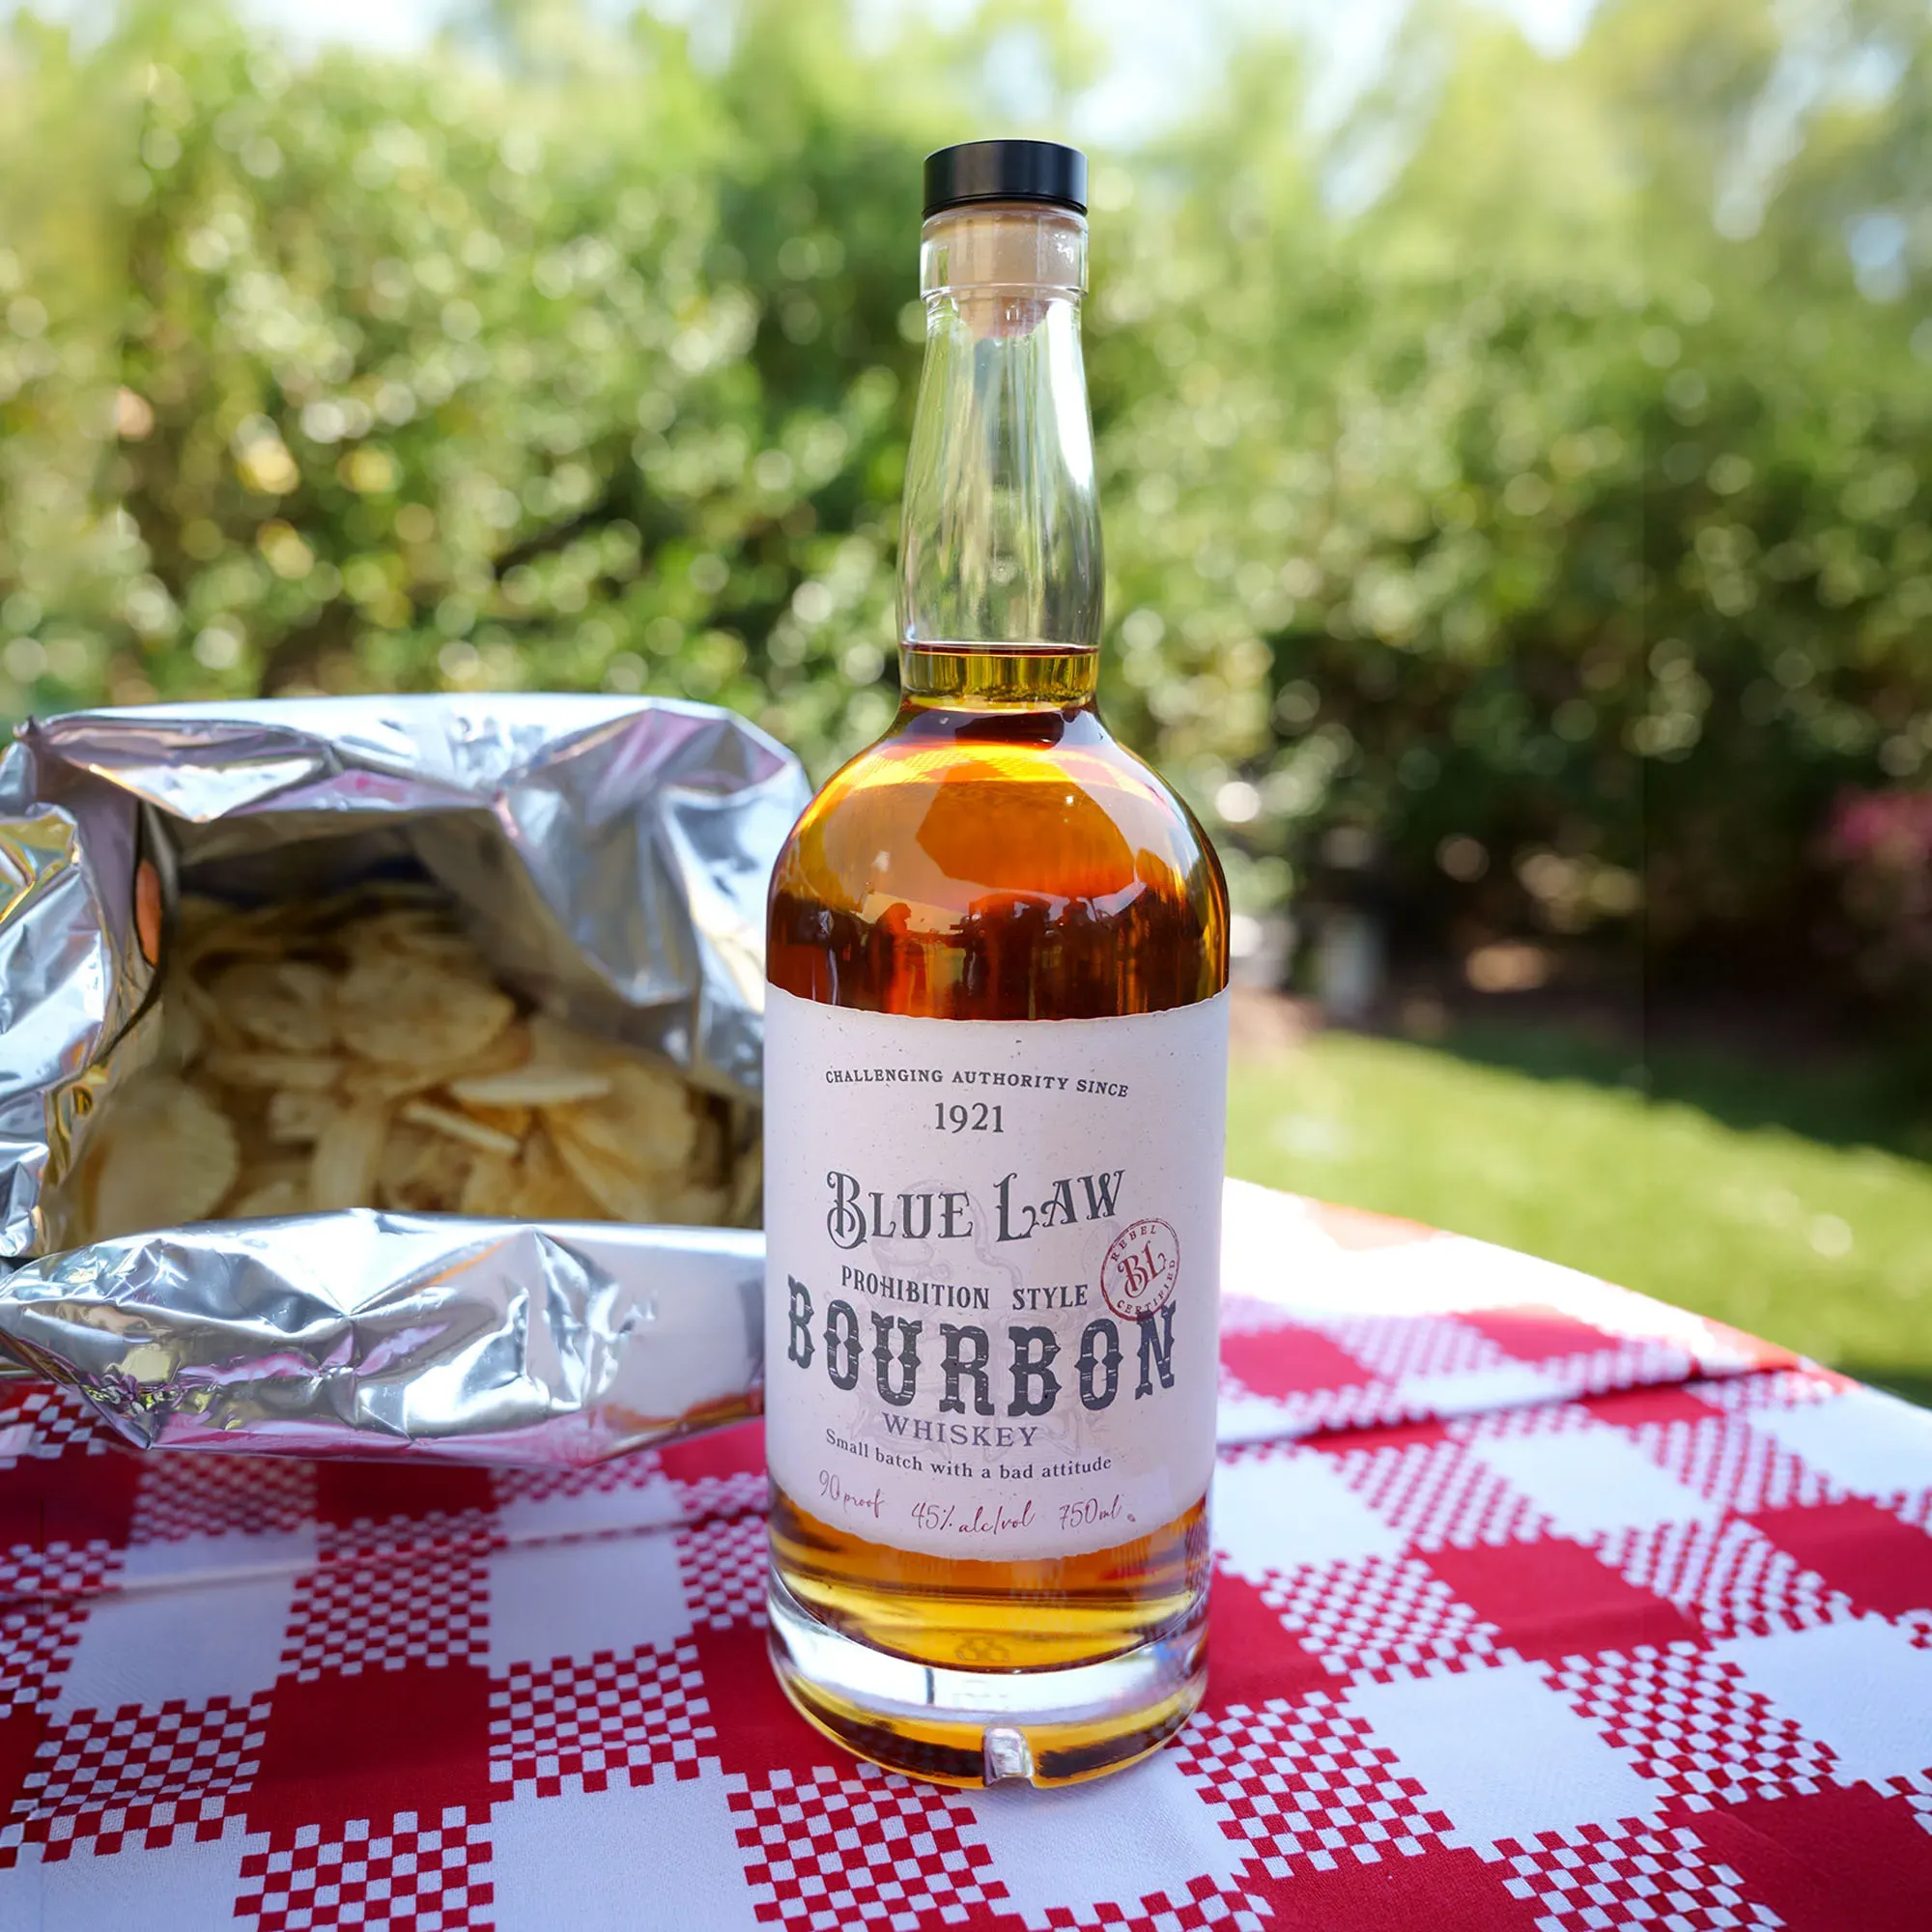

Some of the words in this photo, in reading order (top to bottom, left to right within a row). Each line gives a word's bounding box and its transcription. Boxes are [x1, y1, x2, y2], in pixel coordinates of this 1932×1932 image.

[826, 1068, 944, 1084] CHALLENGING
[952, 1070, 1069, 1091] AUTHORITY
[1076, 1078, 1129, 1097] SINCE
[934, 1101, 1005, 1133] 1921
[1111, 1225, 1158, 1263] REBEL
[841, 1264, 990, 1310] PROHIBITION
[1012, 1284, 1089, 1311] STYLE
[1117, 1240, 1168, 1298] BL
[1117, 1260, 1176, 1315] CERTIFIED
[787, 1273, 1177, 1417] BOURBON
[882, 1411, 1038, 1447] WHISKEY
[826, 1428, 868, 1458] Small
[875, 1447, 923, 1471] batch
[930, 1462, 973, 1478] with
[981, 1467, 991, 1479] a
[1000, 1463, 1033, 1480] bad
[1041, 1456, 1112, 1478] attitude
